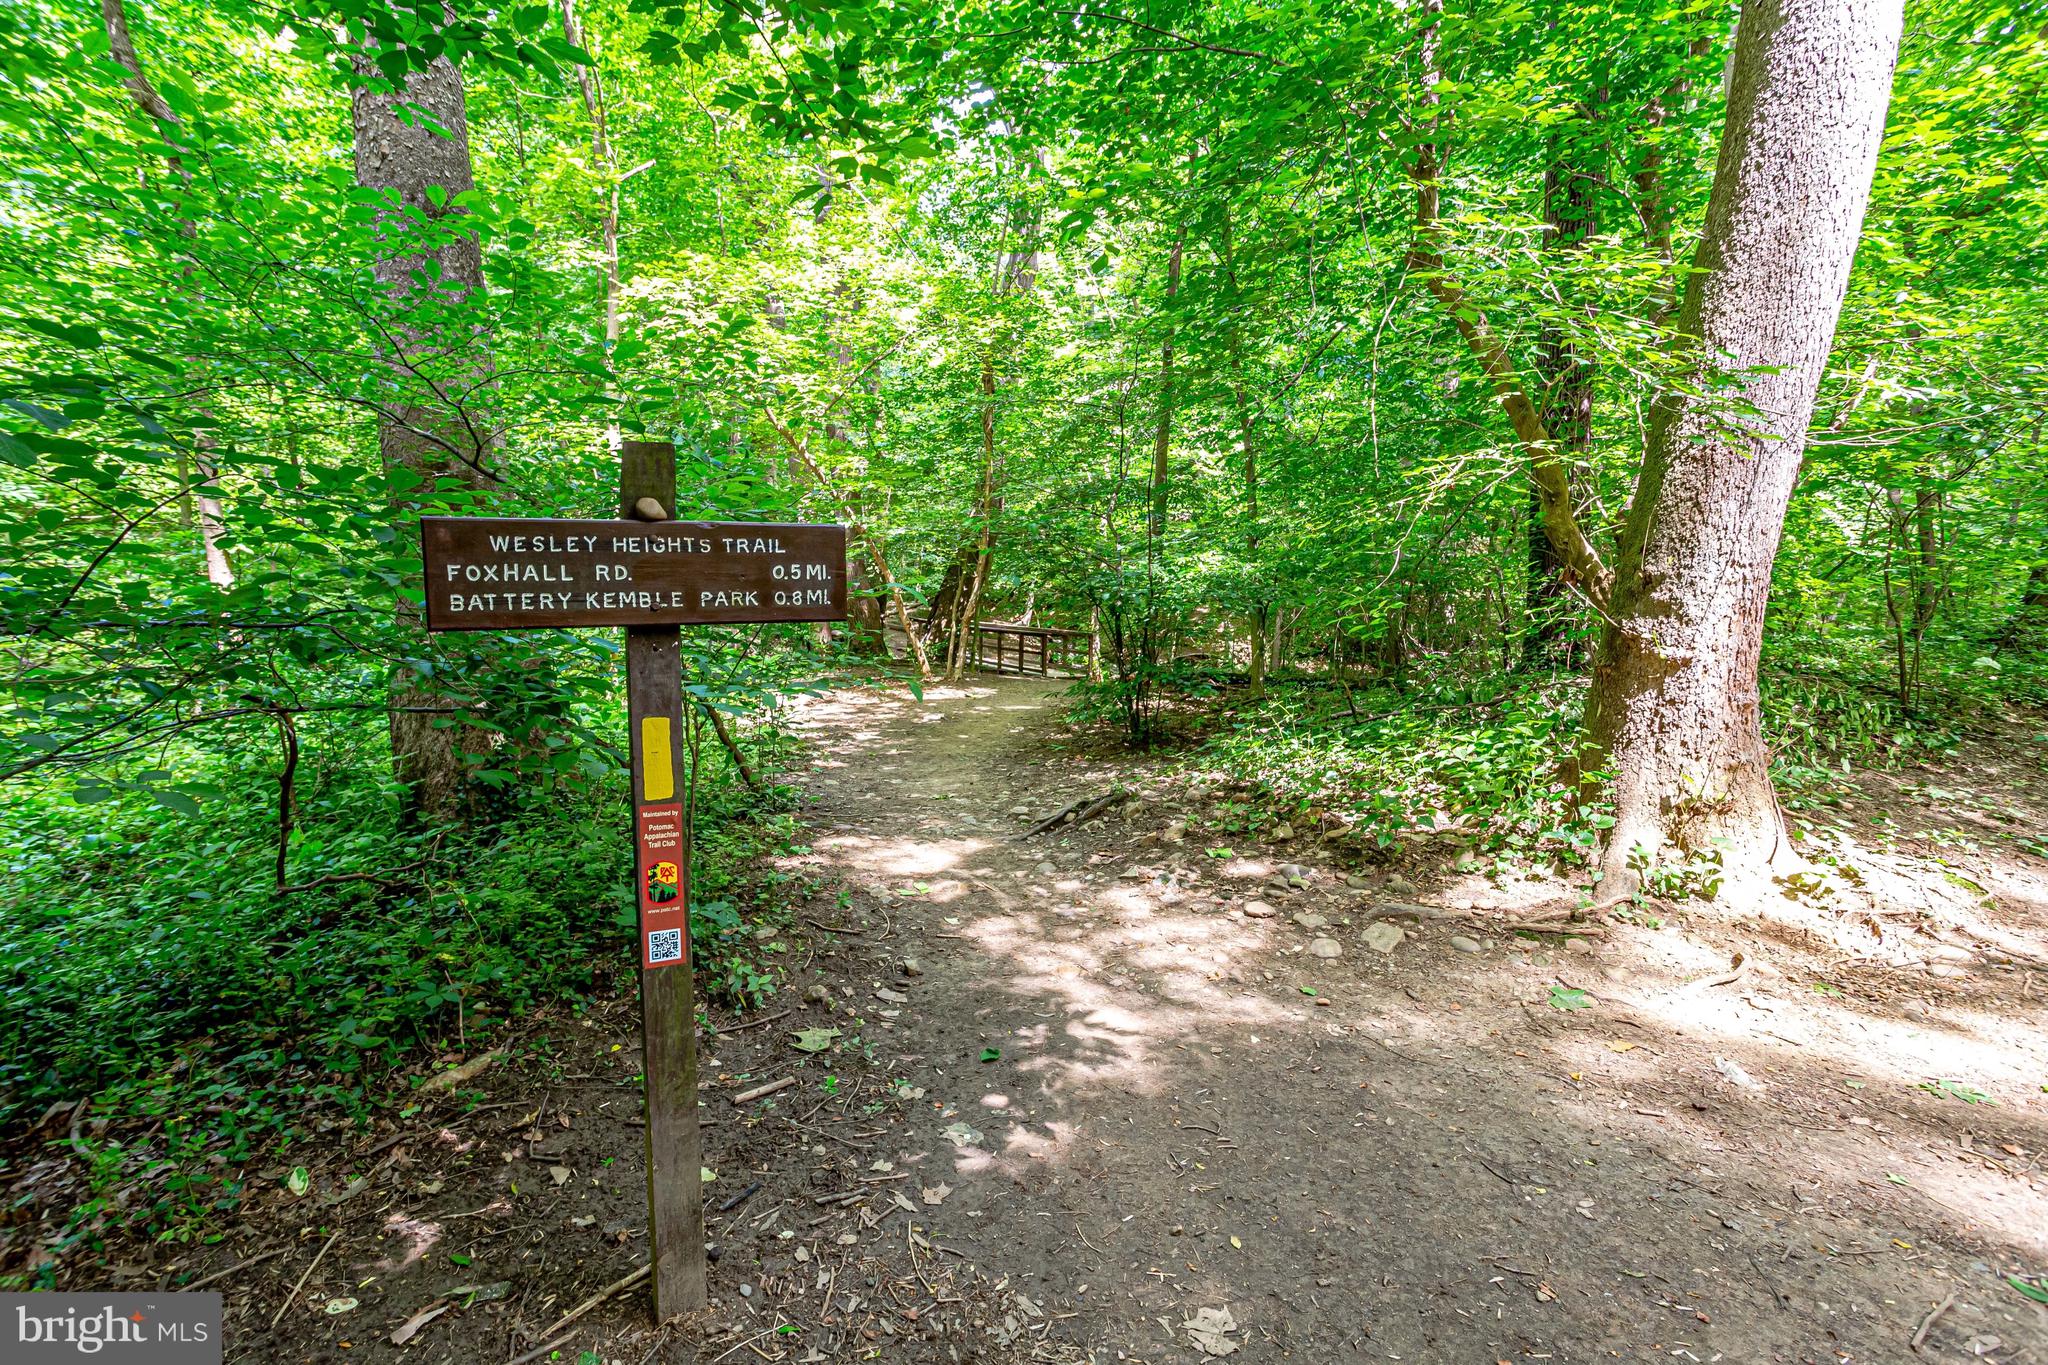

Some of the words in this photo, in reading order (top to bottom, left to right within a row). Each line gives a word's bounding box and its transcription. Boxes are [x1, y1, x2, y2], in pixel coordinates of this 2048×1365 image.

[490, 535, 597, 553] WESLEY
[613, 536, 711, 554] HEIGHTS
[722, 538, 786, 554] TRAIL
[447, 564, 574, 582] FOXHALL
[595, 564, 633, 582] RD.
[772, 564, 801, 581] 0.5
[806, 564, 832, 580] MI.
[450, 591, 572, 612] BATTERY
[586, 591, 684, 609] KEMBLE
[701, 591, 759, 607] PARK
[774, 590, 802, 606] 0.8
[806, 589, 831, 605] MI.
[672, 809, 678, 817] by
[644, 831, 680, 840] Appalachian
